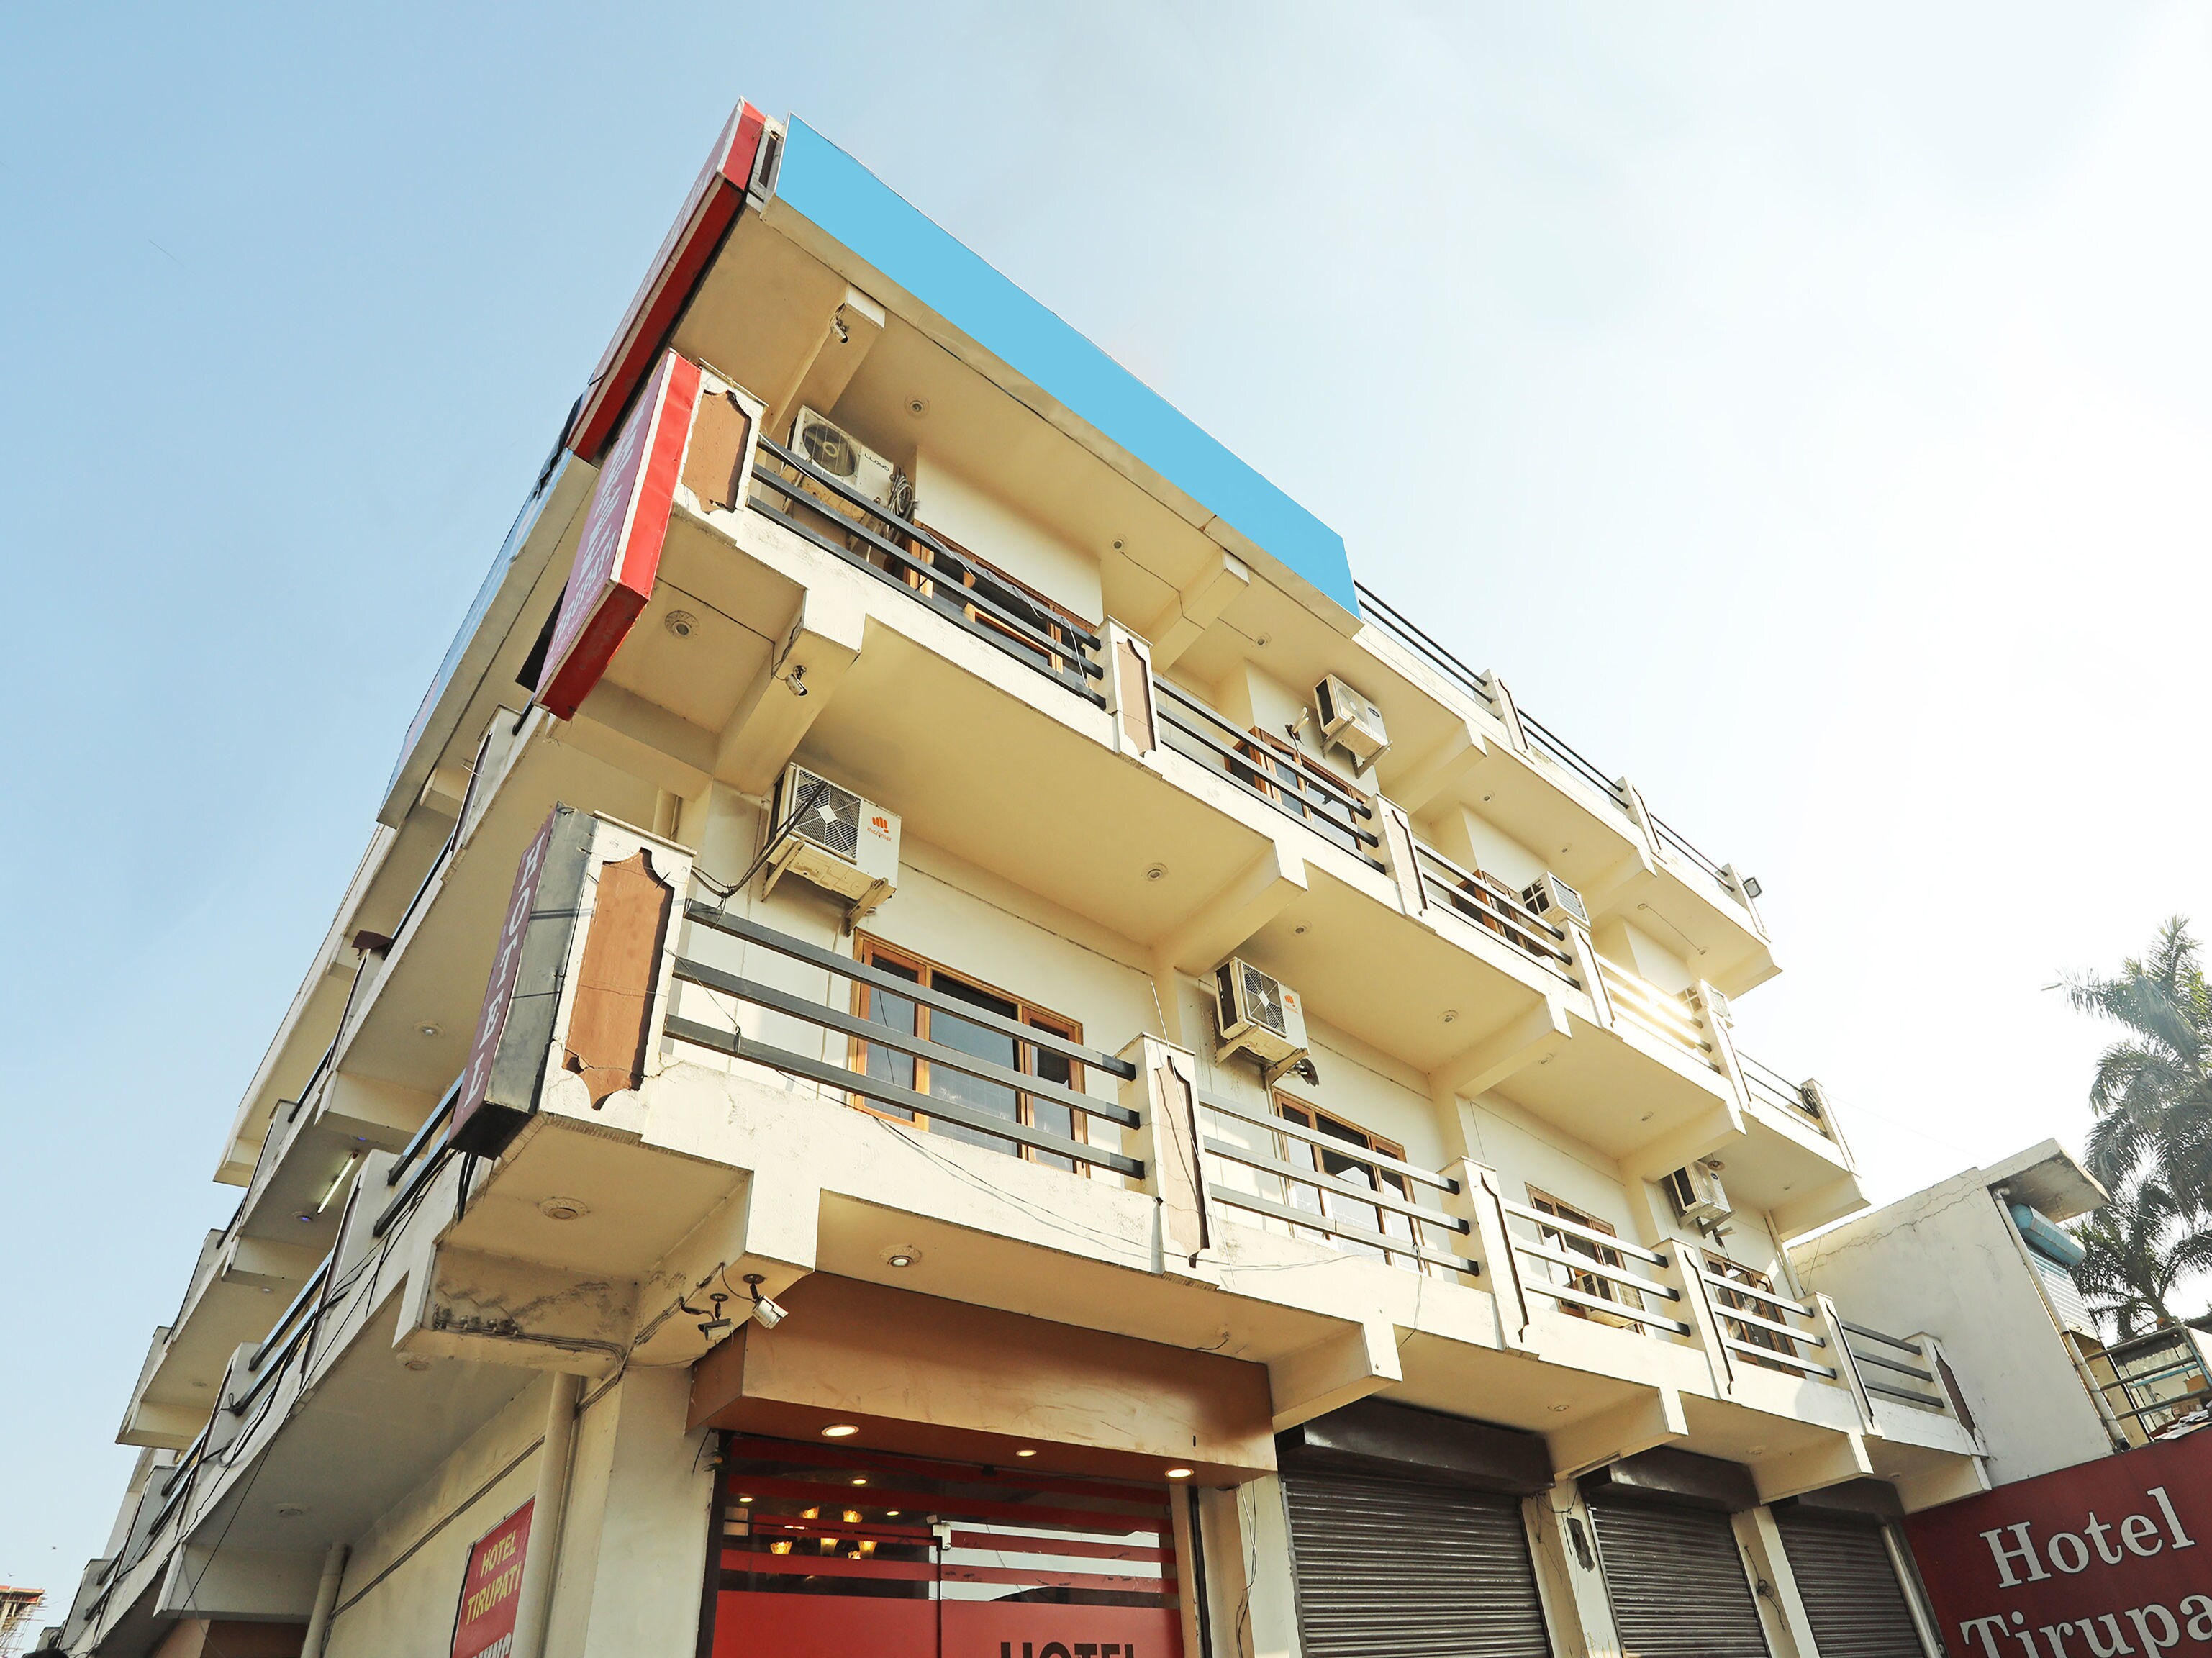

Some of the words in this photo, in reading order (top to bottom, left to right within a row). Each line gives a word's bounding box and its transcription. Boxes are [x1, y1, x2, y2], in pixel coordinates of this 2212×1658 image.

[864, 453, 889, 471] LLOYD
[464, 832, 545, 1106] HOTEL
[480, 1530, 516, 1578] HOTEL
[1979, 1486, 2195, 1589] Hotel
[466, 1561, 522, 1625] TIRUPATI
